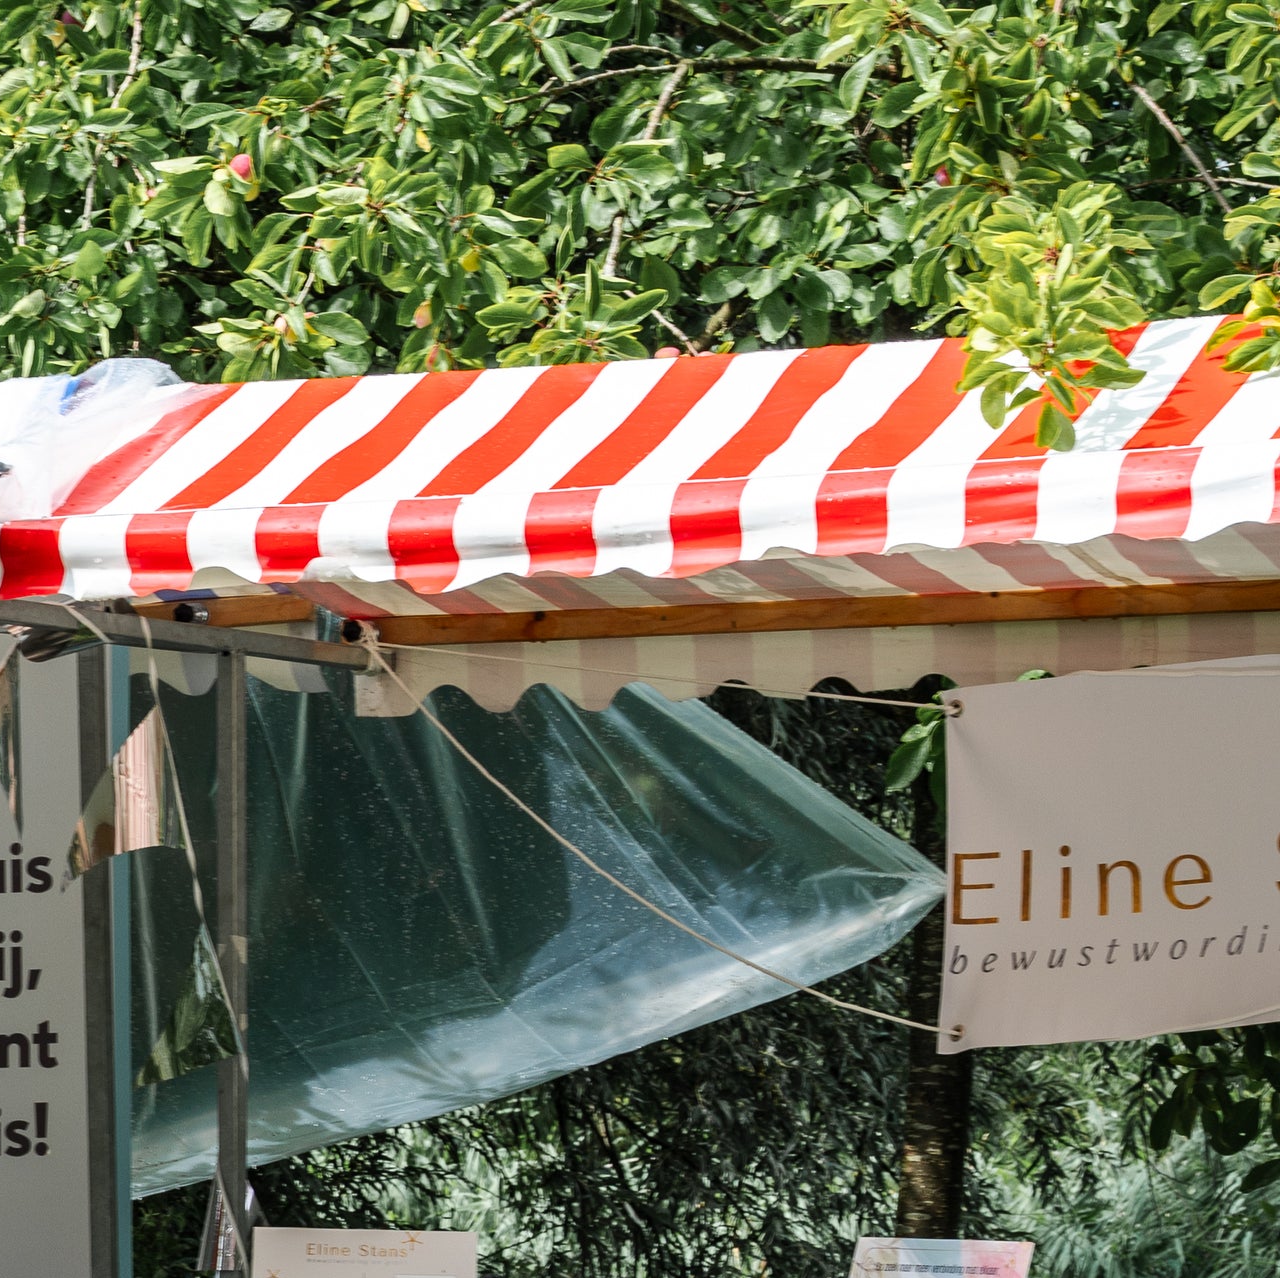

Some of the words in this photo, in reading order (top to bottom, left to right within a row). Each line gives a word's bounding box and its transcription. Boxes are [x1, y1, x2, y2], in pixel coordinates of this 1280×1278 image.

[951, 846, 1213, 925] Eline
[949, 926, 1280, 975] bewustwordi
[306, 1243, 351, 1256] Eline
[358, 1244, 408, 1258] Stans
